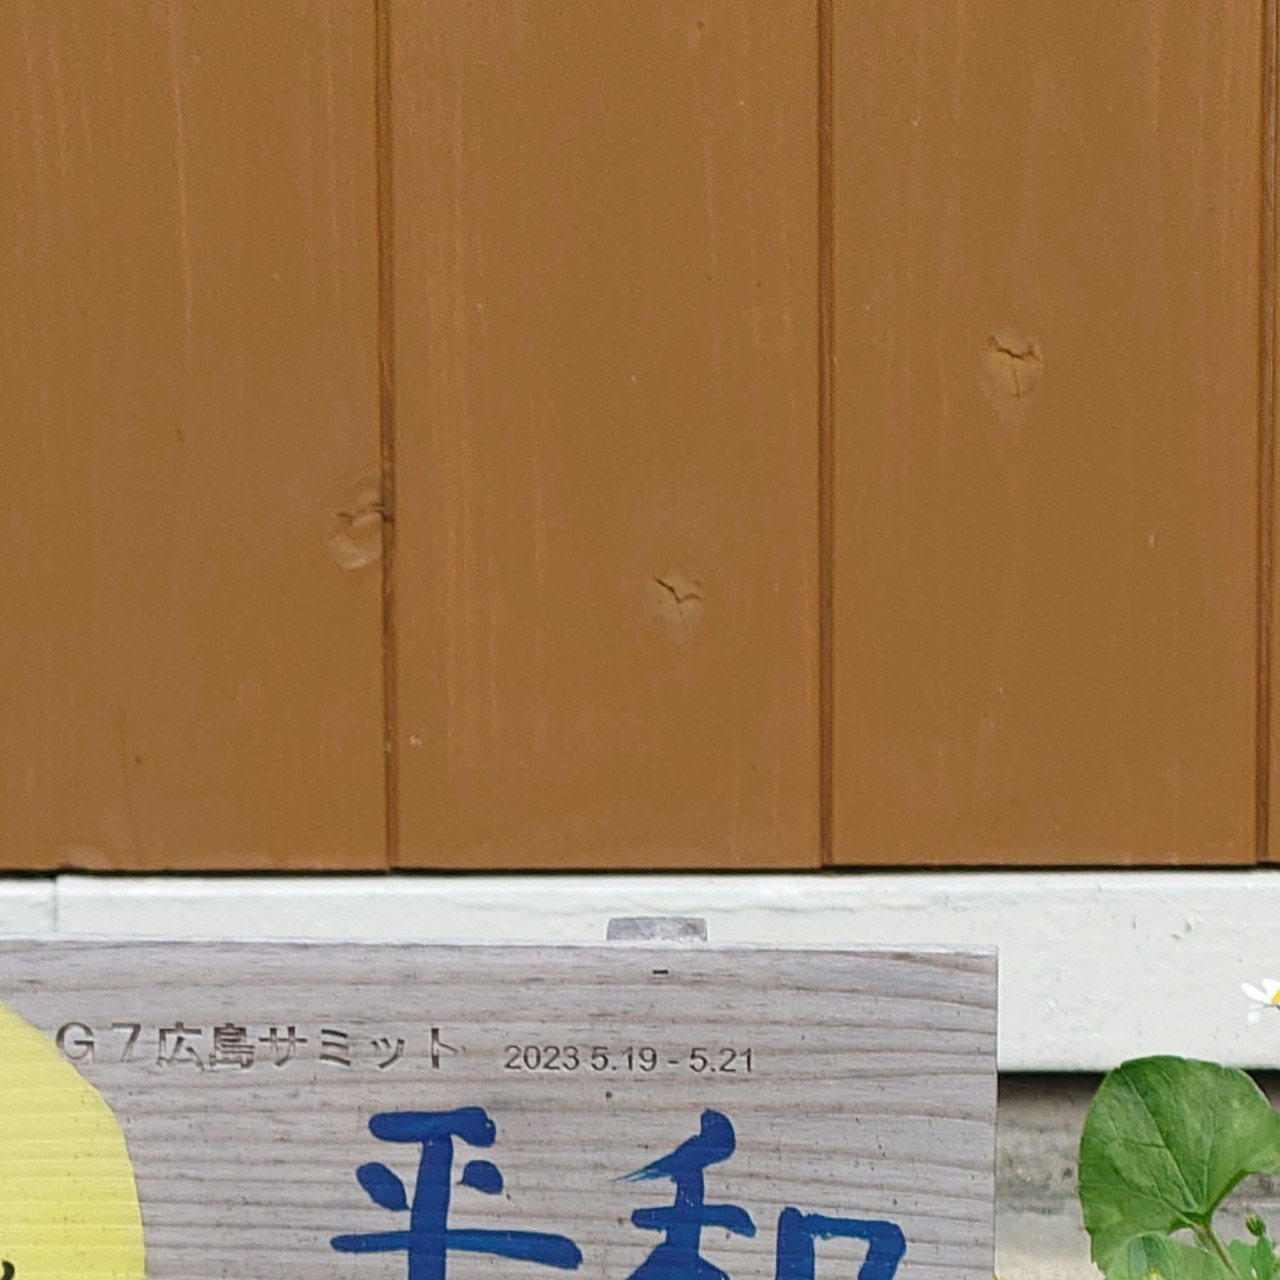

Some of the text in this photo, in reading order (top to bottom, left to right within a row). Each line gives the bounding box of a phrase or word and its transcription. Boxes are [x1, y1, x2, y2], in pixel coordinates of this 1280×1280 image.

[504, 1044, 580, 1071] 2023
[590, 1046, 658, 1072] 5.19
[689, 1047, 754, 1073] 5.21
